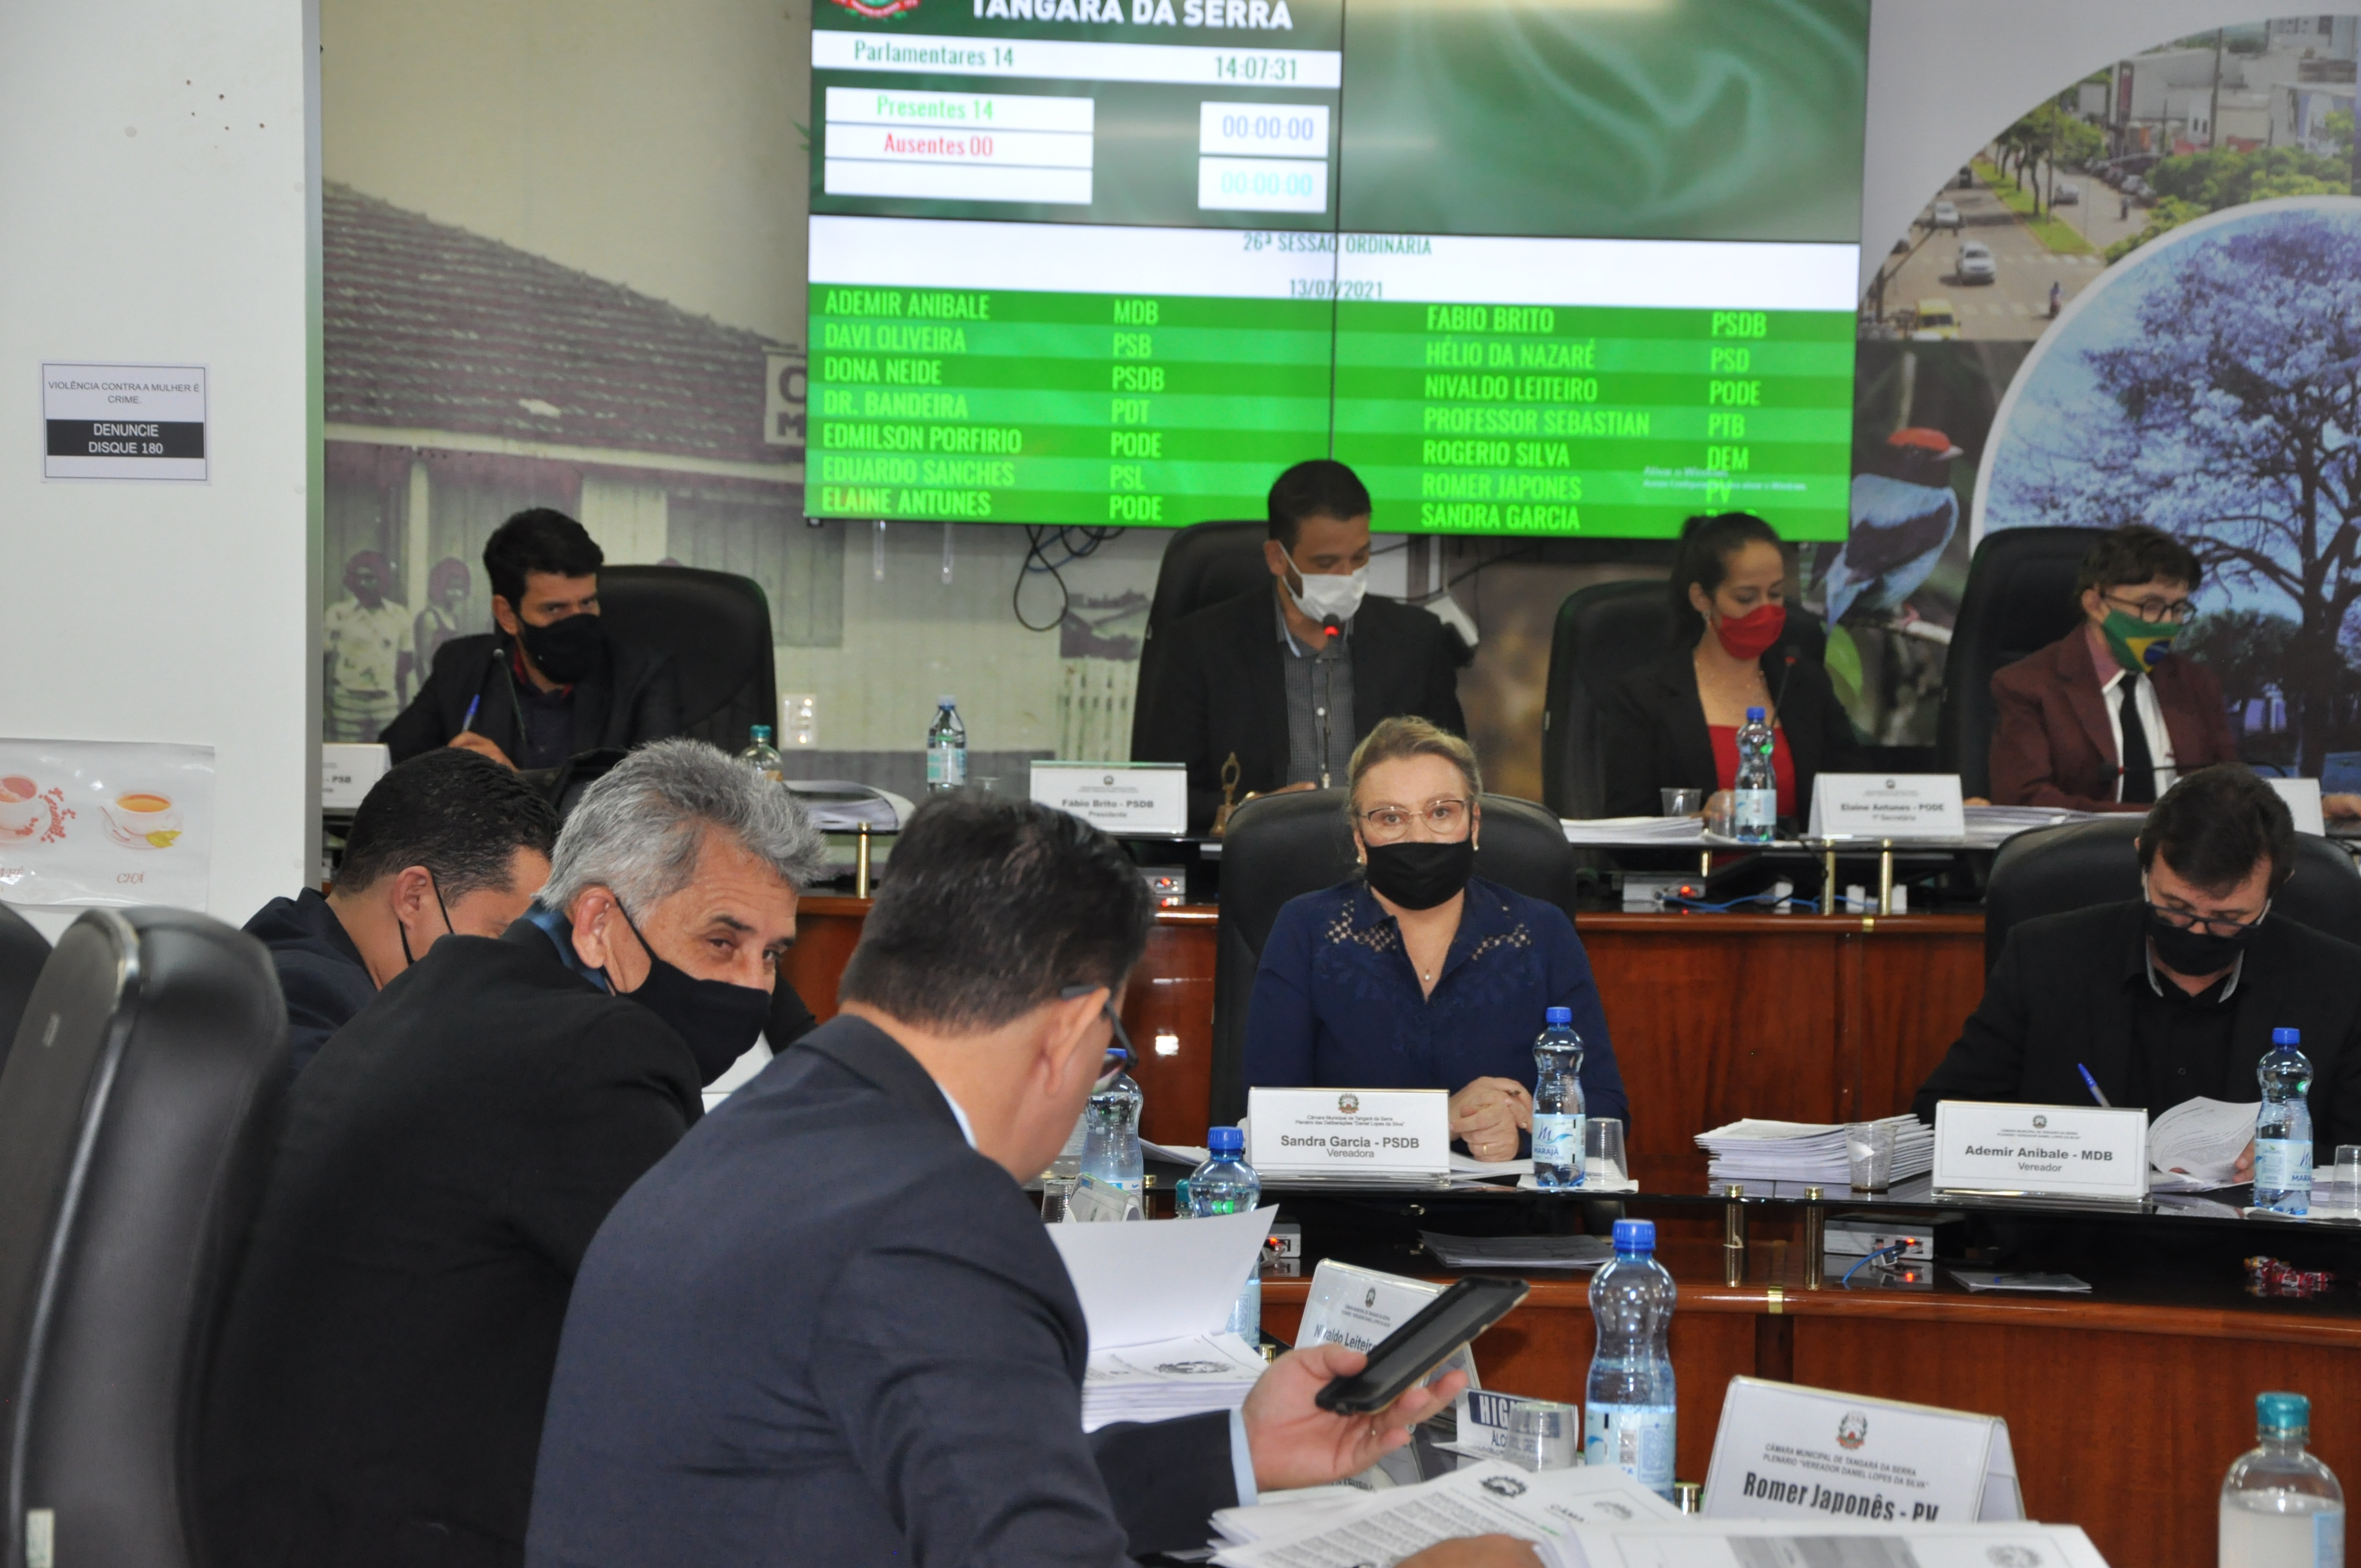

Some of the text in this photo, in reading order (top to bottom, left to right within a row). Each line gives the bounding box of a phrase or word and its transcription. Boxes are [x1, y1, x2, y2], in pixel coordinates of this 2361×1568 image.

[1133, 0, 1177, 26] DA
[1184, 0, 1293, 30] SERRA
[855, 40, 1014, 67] Parlamentares 14
[1216, 56, 1298, 81] 14:07:31
[877, 95, 994, 121] Presentes 14
[1223, 115, 1314, 140] 00:00:00
[884, 132, 993, 157] Ausentes 00
[1221, 172, 1313, 197] 00:00:00
[1290, 279, 1383, 298] 13/07/2021
[825, 290, 991, 320] ADEMIR ANIBALE
[1113, 300, 1159, 325] MDB
[1427, 304, 1555, 333] FABIO BRITO
[1711, 311, 1767, 338] PSDB
[825, 324, 967, 353] DAVI OLIVEIRA
[1112, 332, 1152, 359] PSB
[1426, 334, 1596, 369] HÉLIO DA NAZARÉ
[824, 356, 942, 385] DONA NEIDE
[1711, 347, 1750, 373] PSD
[48, 380, 199, 393] VIOLÊNCIA CONTRA A MULHER É
[1112, 365, 1165, 393] PSDB
[1425, 374, 1598, 403] NIVALDO LEITEIRO
[1709, 379, 1761, 406] PODE
[107, 395, 142, 404] CRIME.
[823, 389, 969, 420] DR. BANDEIRA
[93, 423, 159, 437] DENUNCIE
[1424, 406, 1651, 437] PROFESSOR SEBASTIAN
[1708, 412, 1745, 439] PTB
[88, 441, 164, 454] DISQUE 180
[823, 422, 1022, 454] EDMILSON PORFIRIO
[1110, 431, 1162, 458] PODE
[1423, 439, 1570, 467] ROGERIO SILVA
[1707, 445, 1749, 471] DEM
[823, 455, 1015, 487] EDUARDO SANCHES
[1109, 464, 1146, 491] PSL
[1422, 472, 1492, 498] ROMER
[822, 486, 991, 516] ELAINE ANTUNES
[1109, 494, 1162, 521] PODE
[1421, 502, 1580, 531] SANDRA GARCIA
[116, 872, 145, 884] CHÁ
[1281, 1135, 1326, 1147] Sandra
[1330, 1136, 1371, 1148] Garcia
[1383, 1137, 1419, 1149] PSDB
[1326, 1148, 1375, 1158] Vereadora
[1965, 1145, 2014, 1157] Ademir
[2017, 1147, 2069, 1159] Anibale
[2081, 1150, 2113, 1161] MDB
[2018, 1162, 2063, 1173] Vereador
[1743, 1471, 1809, 1506] Romer
[1810, 1484, 1895, 1521] Japonês
